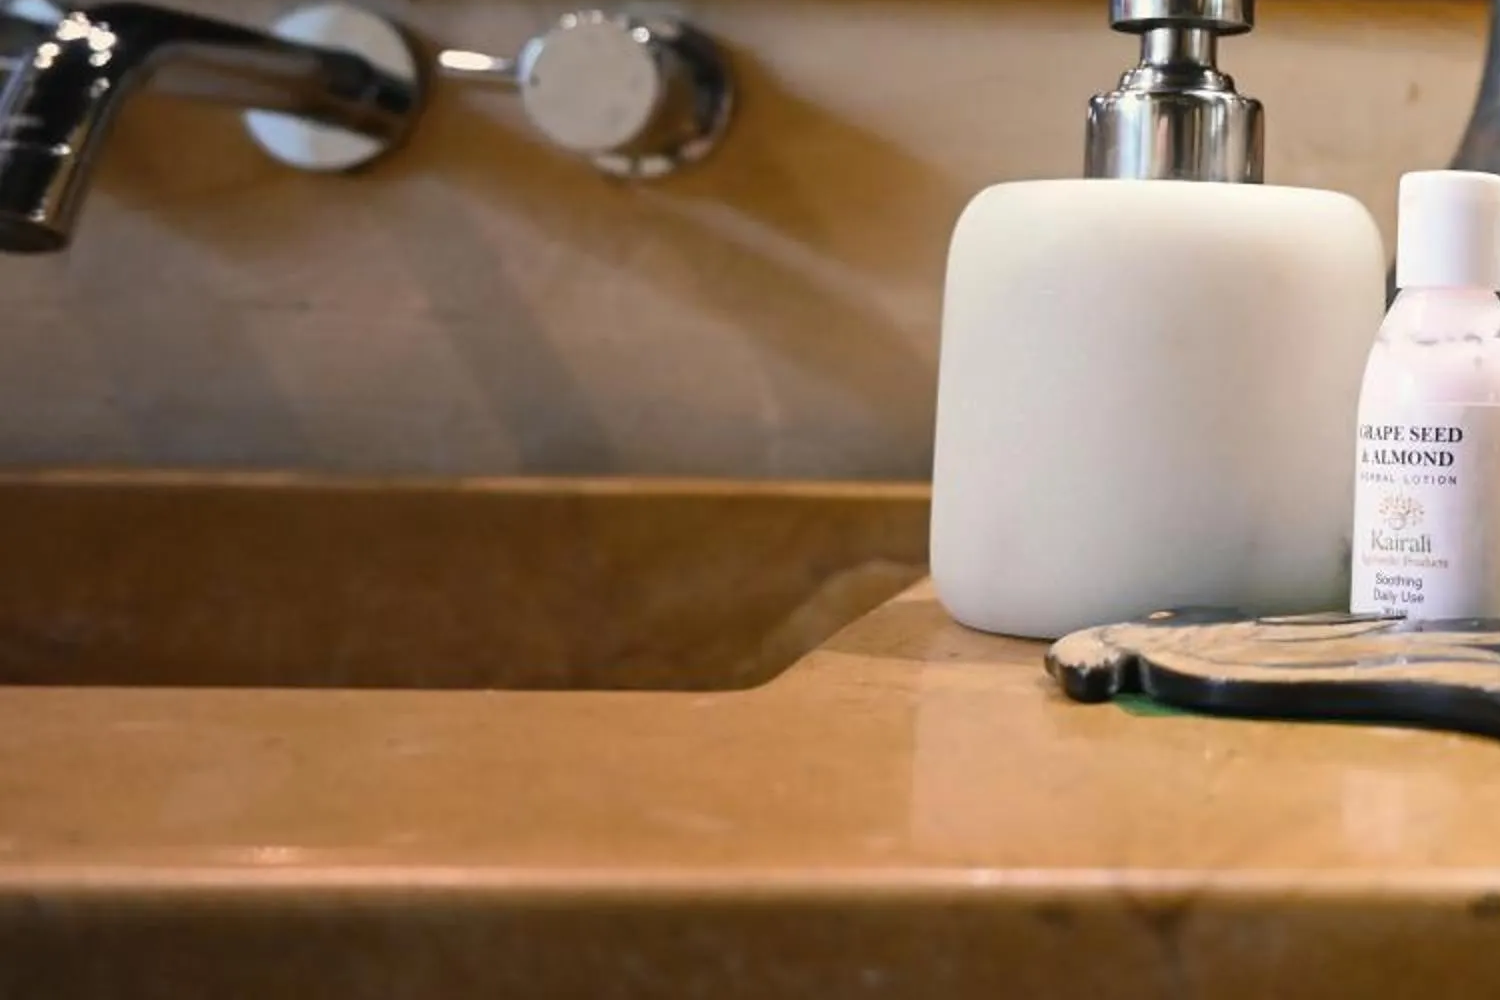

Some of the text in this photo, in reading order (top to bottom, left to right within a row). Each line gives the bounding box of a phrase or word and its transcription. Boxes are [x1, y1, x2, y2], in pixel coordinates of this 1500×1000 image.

[1409, 426, 1463, 443] SEED
[1371, 449, 1454, 467] ALMOND
[1403, 474, 1457, 485] LOTION
[1371, 529, 1432, 553] Kairali
[1375, 571, 1423, 590] Soothing
[1373, 588, 1425, 604] Daily Use
